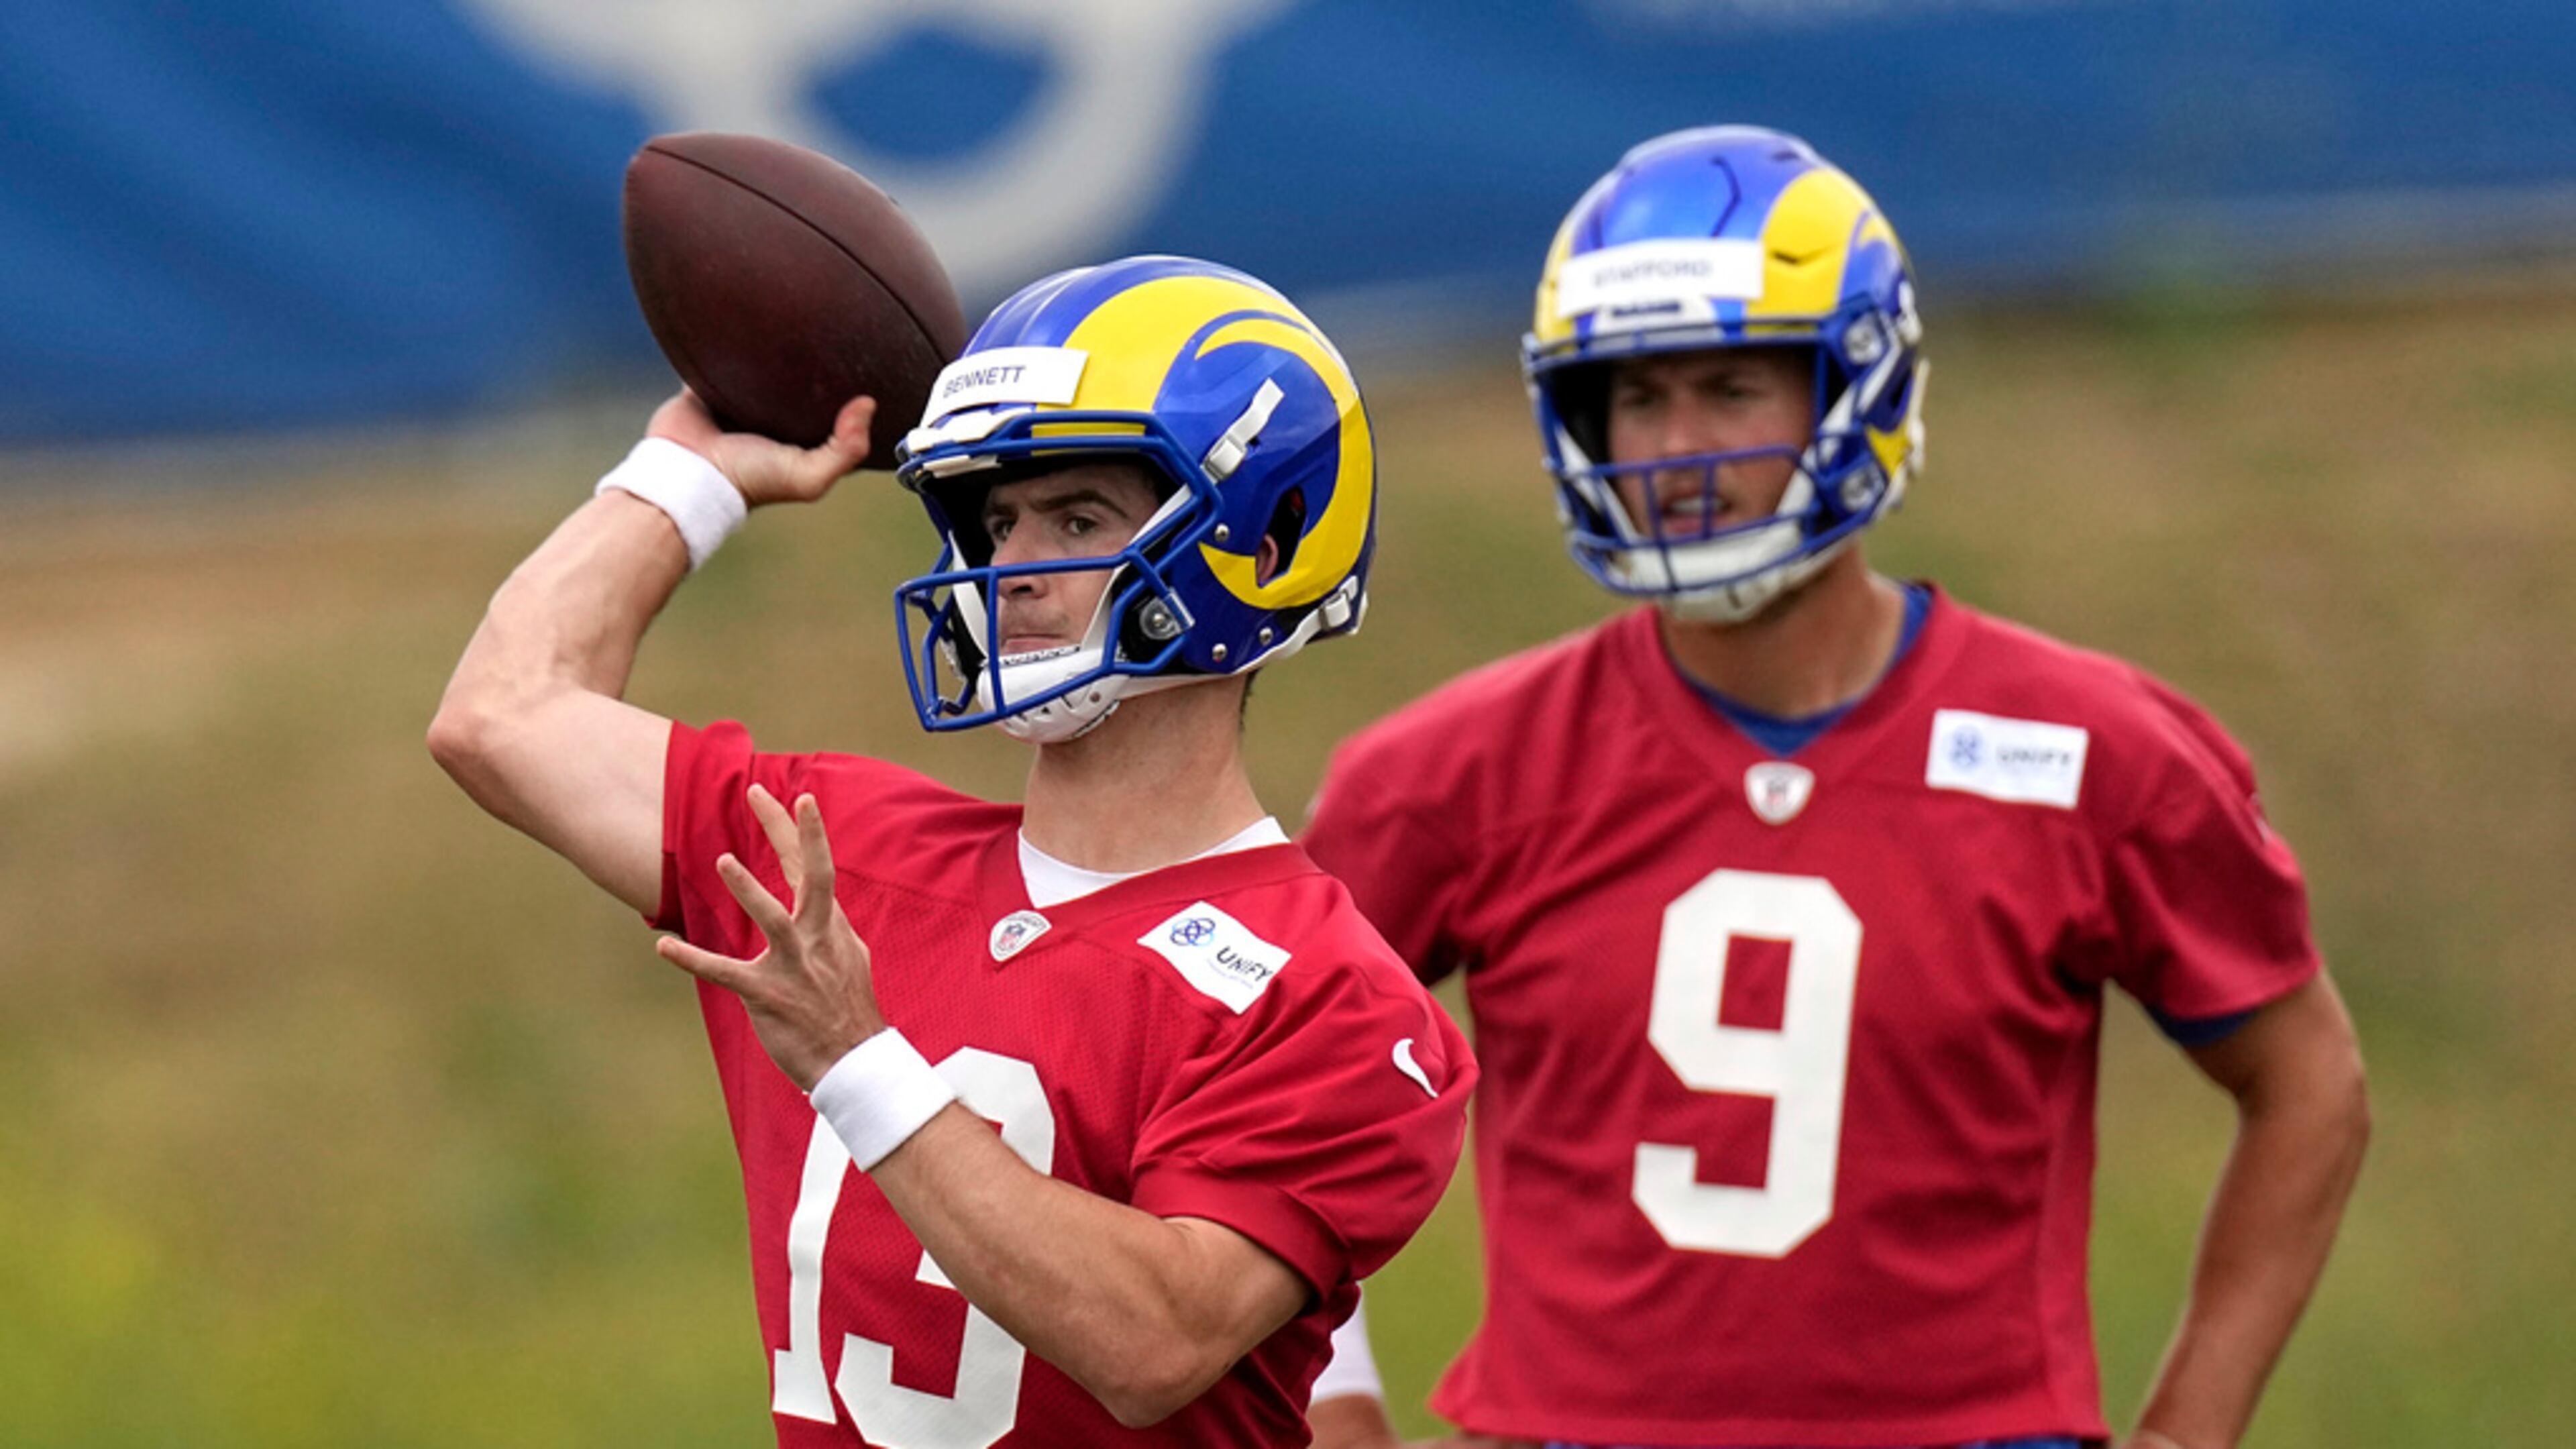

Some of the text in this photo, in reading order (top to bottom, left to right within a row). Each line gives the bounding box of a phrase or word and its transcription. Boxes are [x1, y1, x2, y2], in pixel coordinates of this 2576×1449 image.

[1593, 258, 1712, 288] STAFFORD
[943, 364, 1026, 398] BENNETT
[1216, 945, 1273, 981] UNIFY
[1631, 868, 1864, 1259] 9
[772, 1046, 1055, 1449] 13
